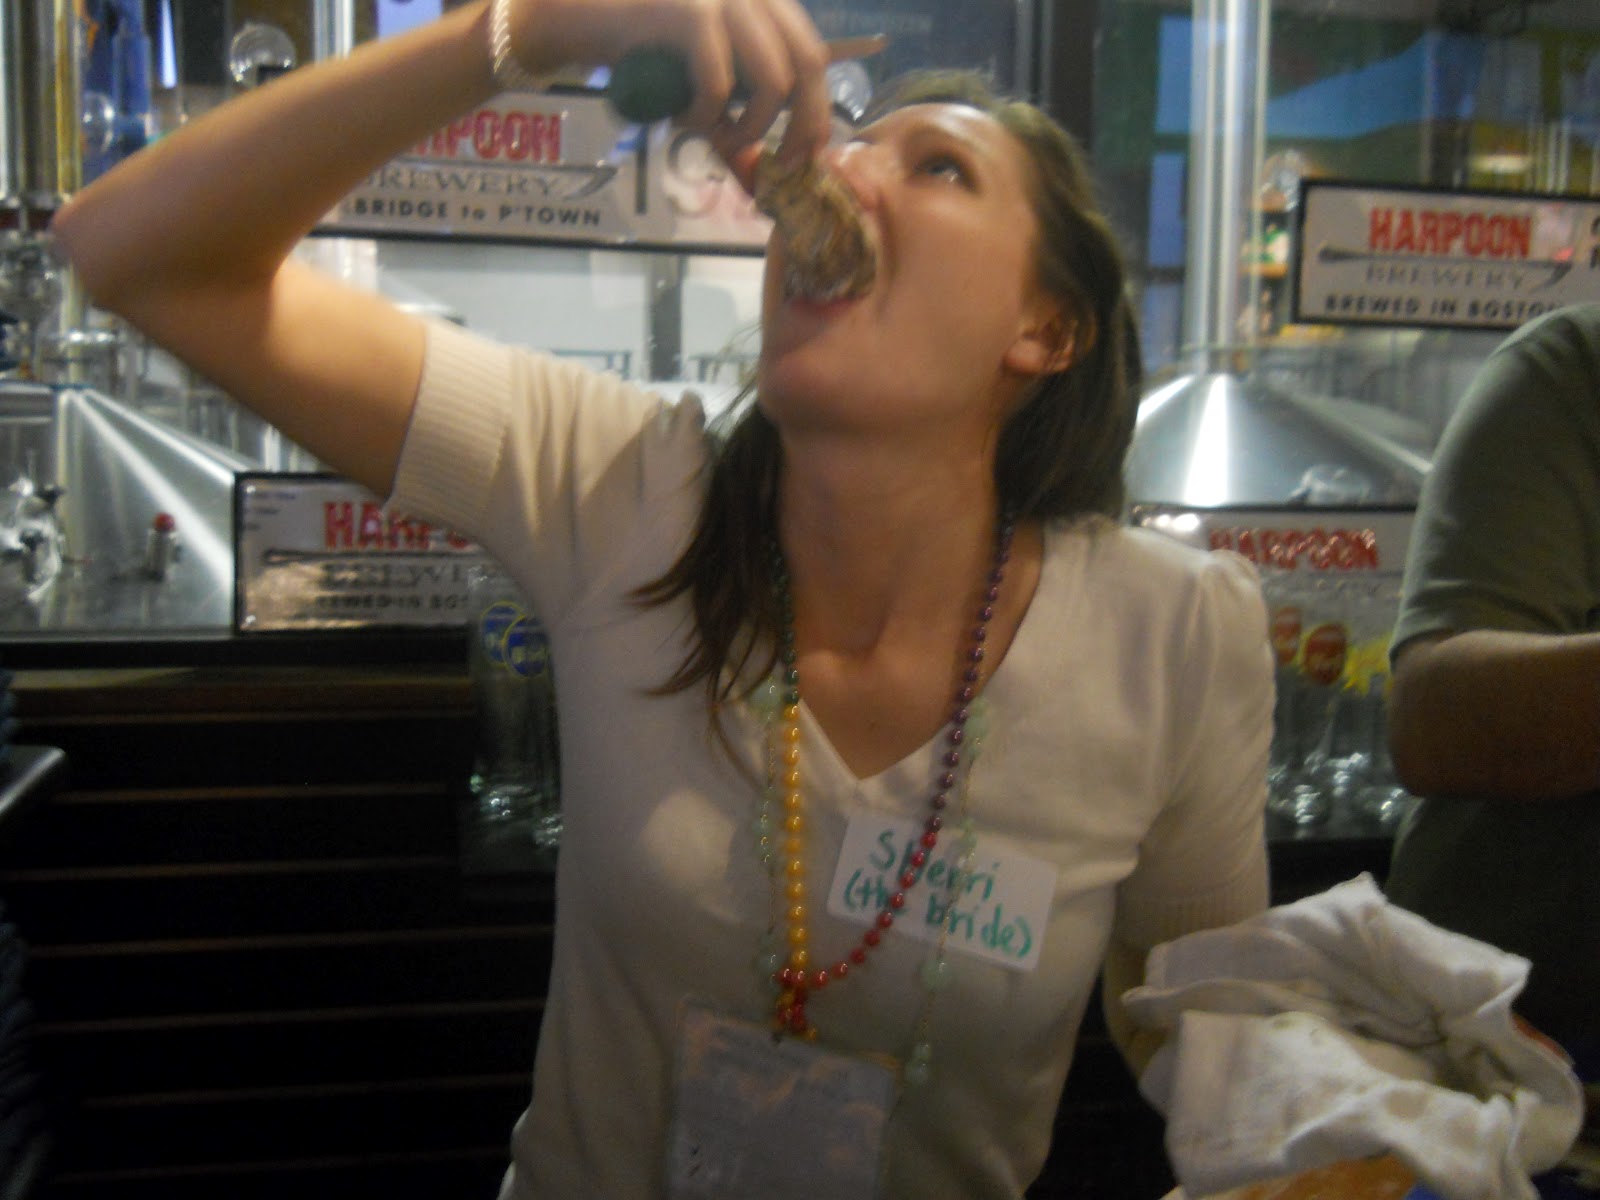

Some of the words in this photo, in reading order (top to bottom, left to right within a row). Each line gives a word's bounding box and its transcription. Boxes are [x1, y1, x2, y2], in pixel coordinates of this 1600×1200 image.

[1369, 207, 1532, 259] HARPOON
[1325, 293, 1418, 313] BREWED
[1431, 300, 1456, 316] IN
